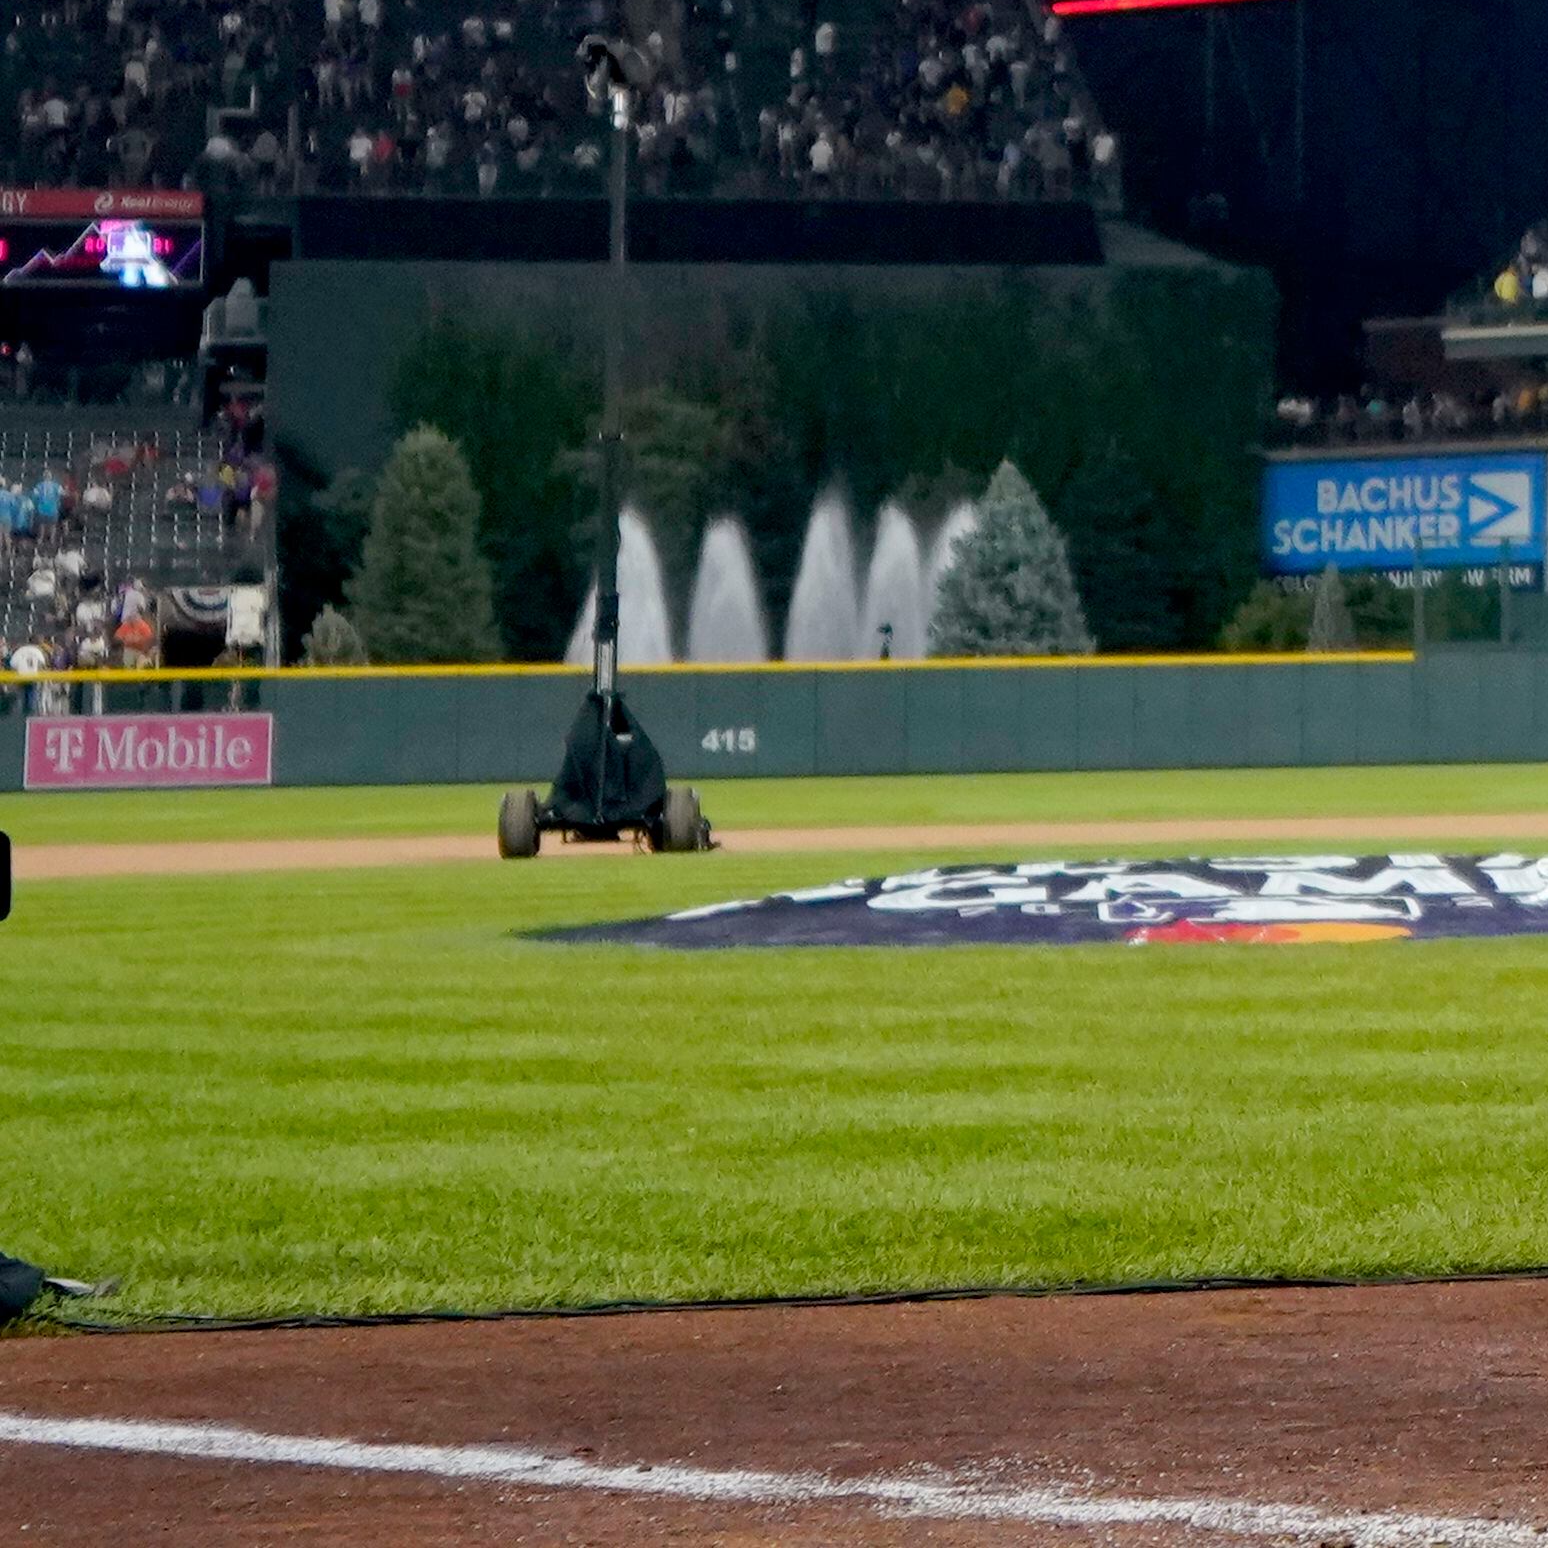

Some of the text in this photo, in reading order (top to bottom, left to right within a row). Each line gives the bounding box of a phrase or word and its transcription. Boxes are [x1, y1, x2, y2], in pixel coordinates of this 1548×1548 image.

[1317, 475, 1461, 513] BACHUS
[1273, 515, 1459, 555] SCHANKER
[95, 724, 252, 772] Mobile
[701, 728, 756, 752] 415
